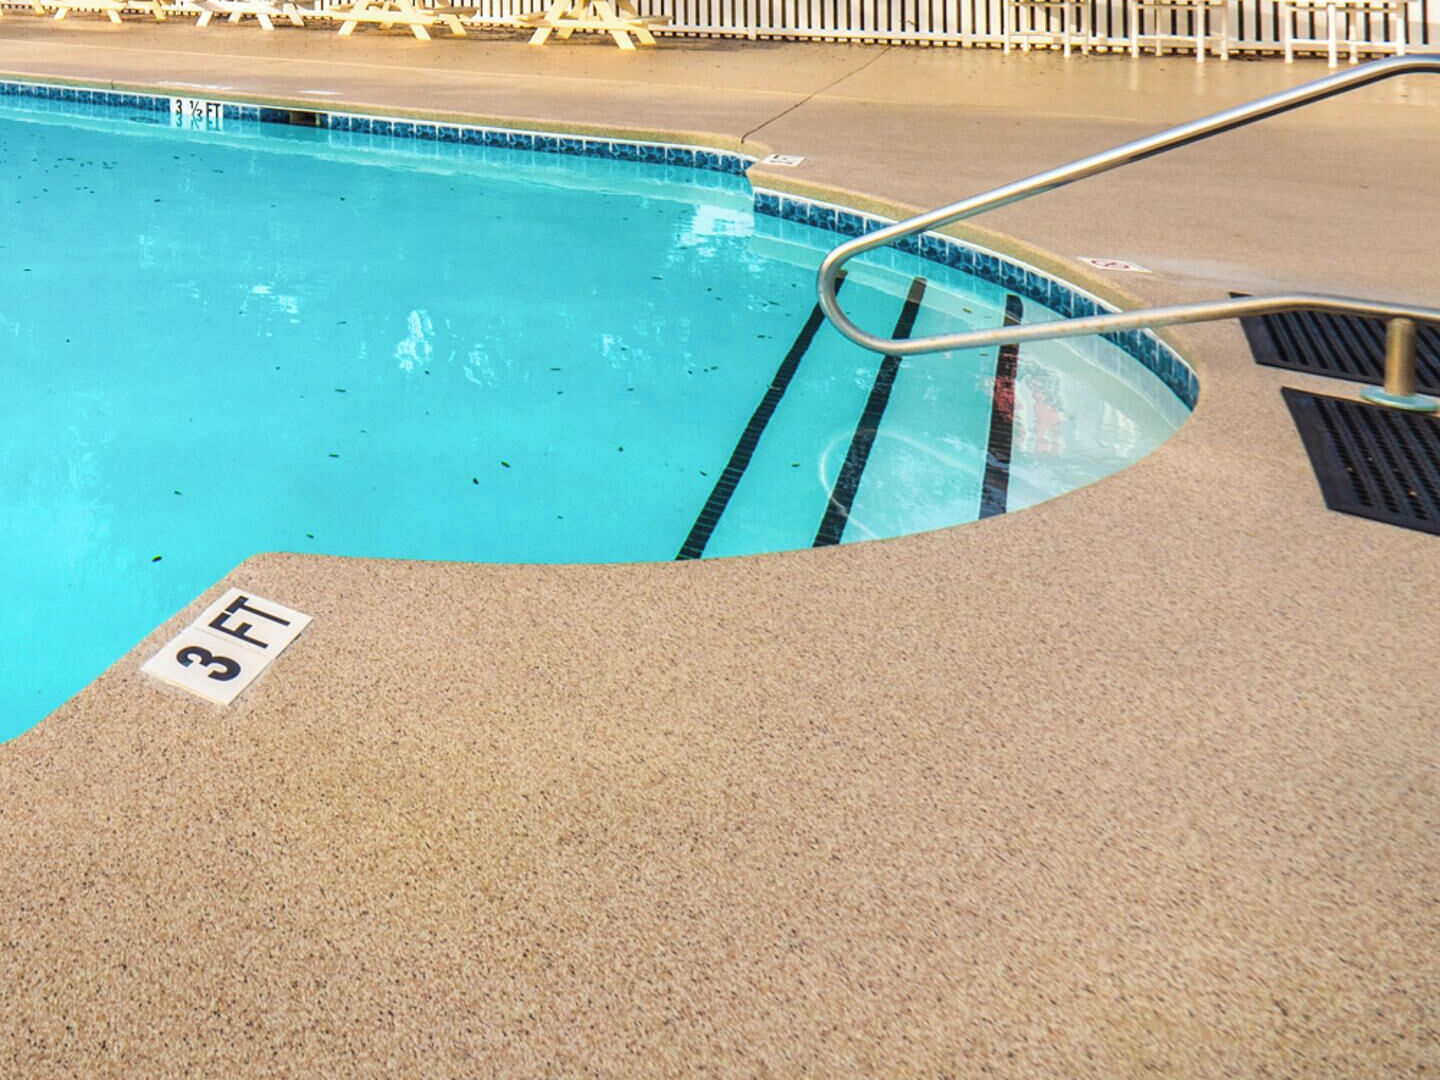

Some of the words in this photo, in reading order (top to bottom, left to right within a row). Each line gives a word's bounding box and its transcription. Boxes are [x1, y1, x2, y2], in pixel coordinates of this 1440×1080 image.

[175, 99, 183, 115] 3
[206, 102, 221, 118] FT
[208, 595, 291, 649] FT
[176, 645, 241, 681] 3
